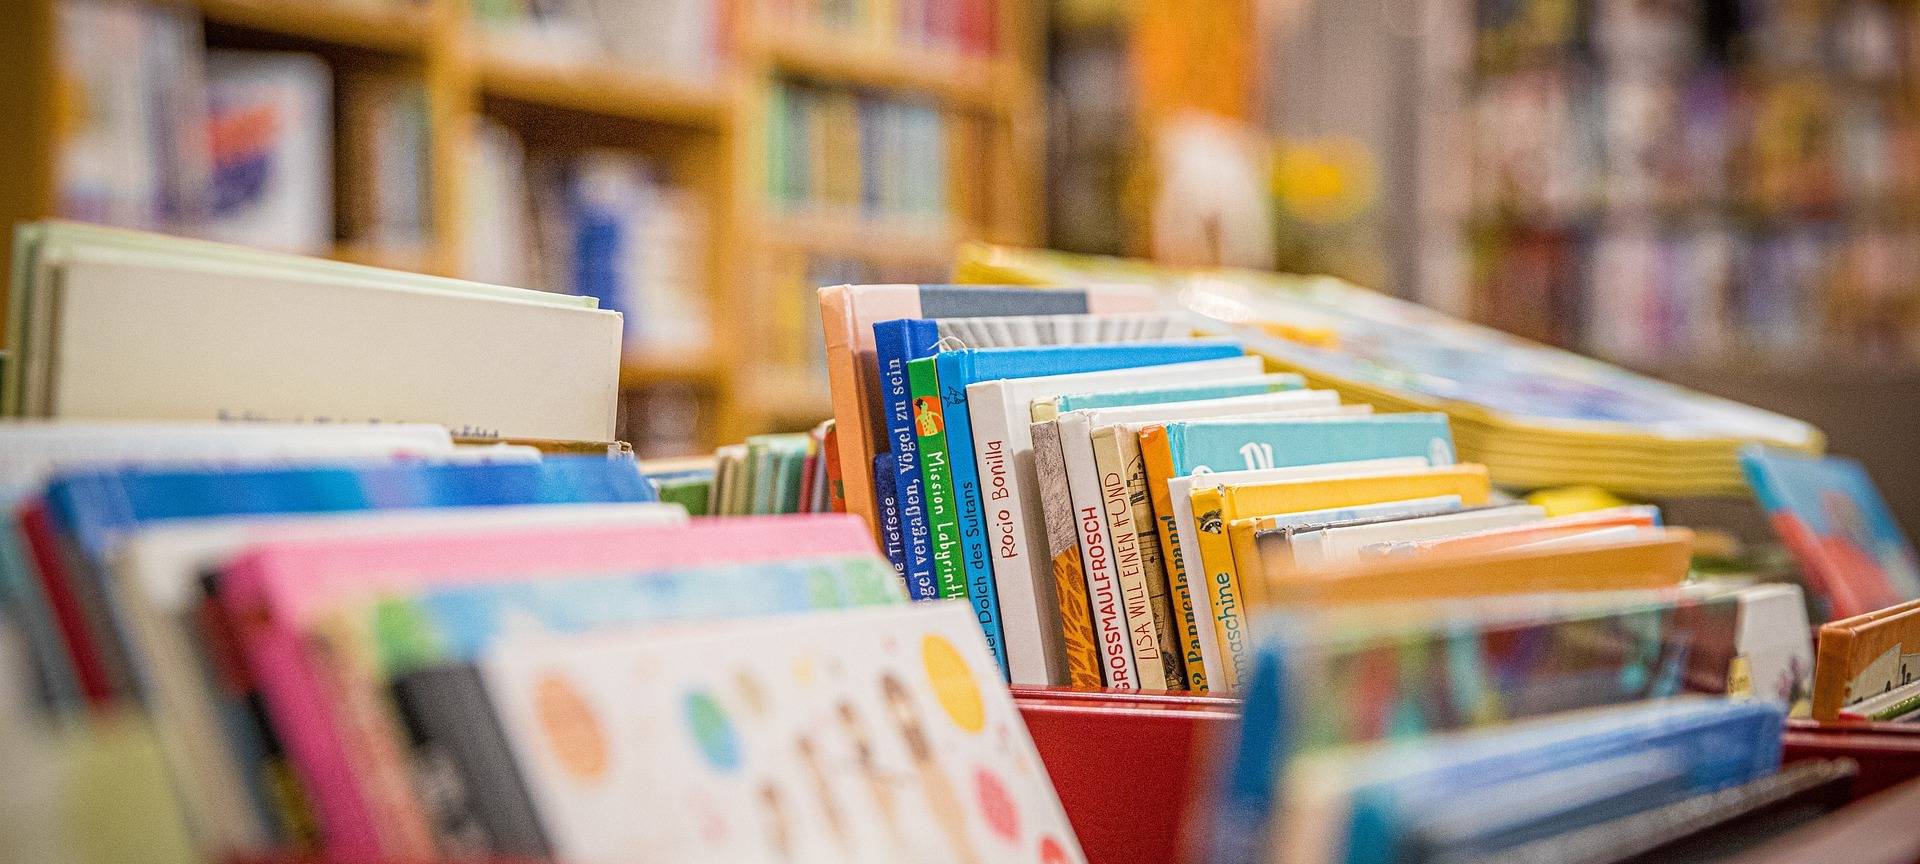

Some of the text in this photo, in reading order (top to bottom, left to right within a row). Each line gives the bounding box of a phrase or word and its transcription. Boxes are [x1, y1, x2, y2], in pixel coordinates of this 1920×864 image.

[887, 358, 904, 395] sein
[895, 400, 908, 420] zu
[894, 426, 916, 474] Vögel
[985, 440, 1009, 500] Bonilla
[885, 496, 902, 556] Tiefsee
[905, 479, 927, 565] vergaßen,
[927, 451, 964, 601] Mission Labyrinth
[964, 481, 980, 537] Sultans
[971, 543, 984, 569] des
[1104, 472, 1159, 660] LISA WILL EINEN HUND
[974, 576, 992, 624] Dolch
[1081, 506, 1131, 689] GROSSMAULFROSCH
